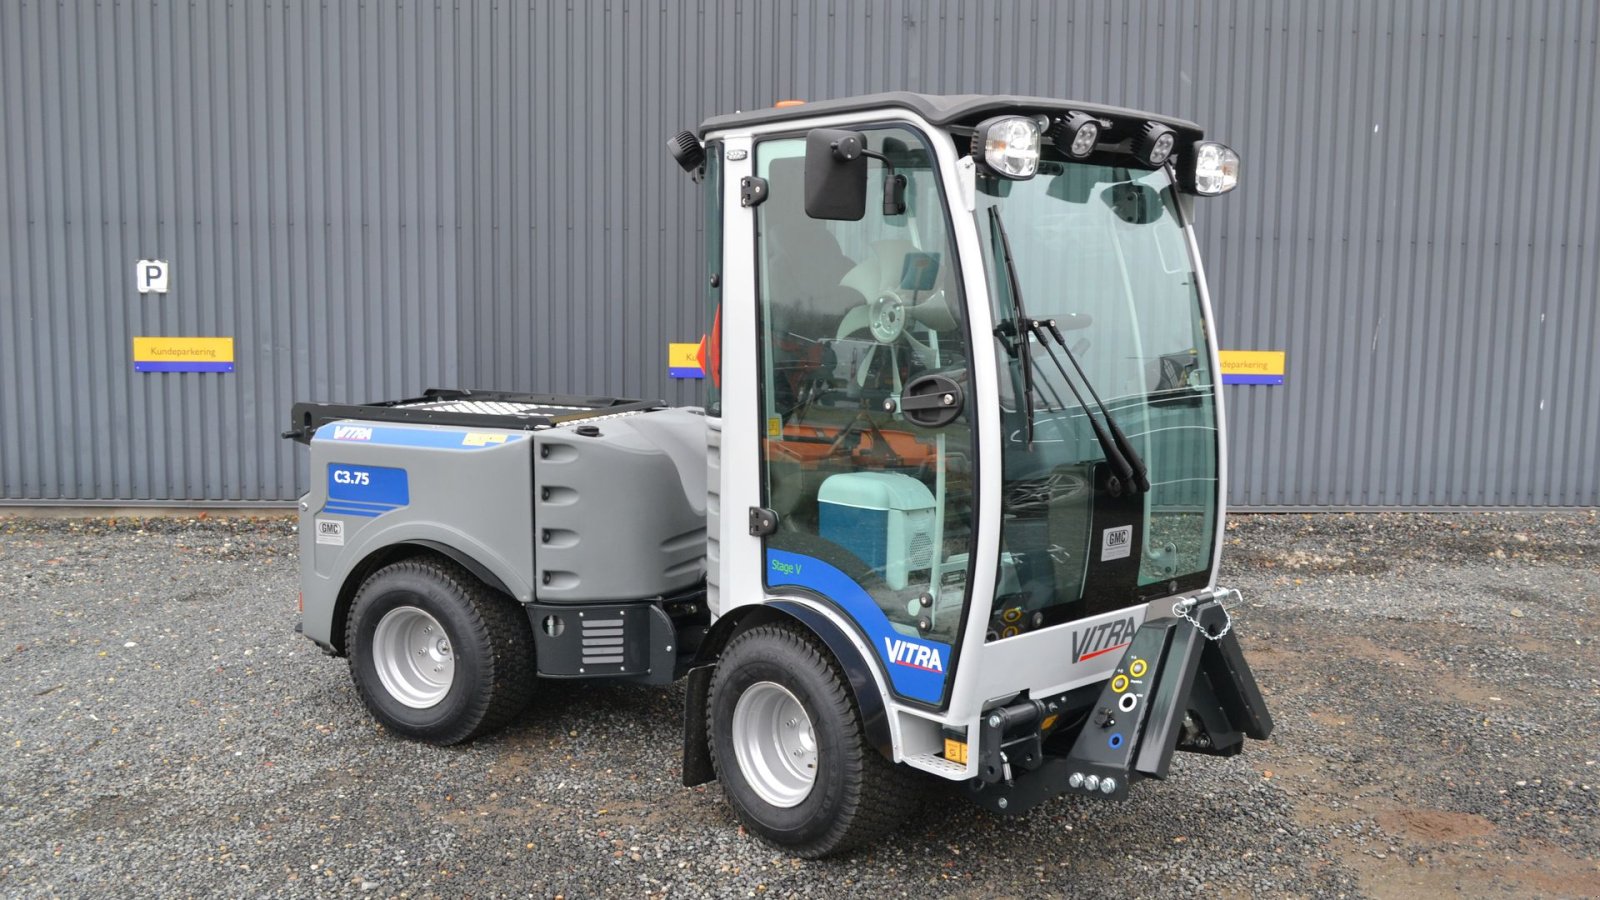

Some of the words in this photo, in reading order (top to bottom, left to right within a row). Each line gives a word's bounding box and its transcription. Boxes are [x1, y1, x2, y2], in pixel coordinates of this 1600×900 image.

[145, 265, 162, 287] P
[150, 347, 216, 358] Kundeparkering
[1220, 361, 1268, 371] deparkering
[334, 425, 372, 440] VITRA
[334, 470, 370, 485] C3.75
[322, 523, 338, 534] GMC
[1109, 531, 1126, 545] GMC
[772, 559, 794, 575] Stage
[796, 564, 802, 575] V
[1072, 617, 1135, 664] VITRA
[884, 637, 943, 672] VITRA
